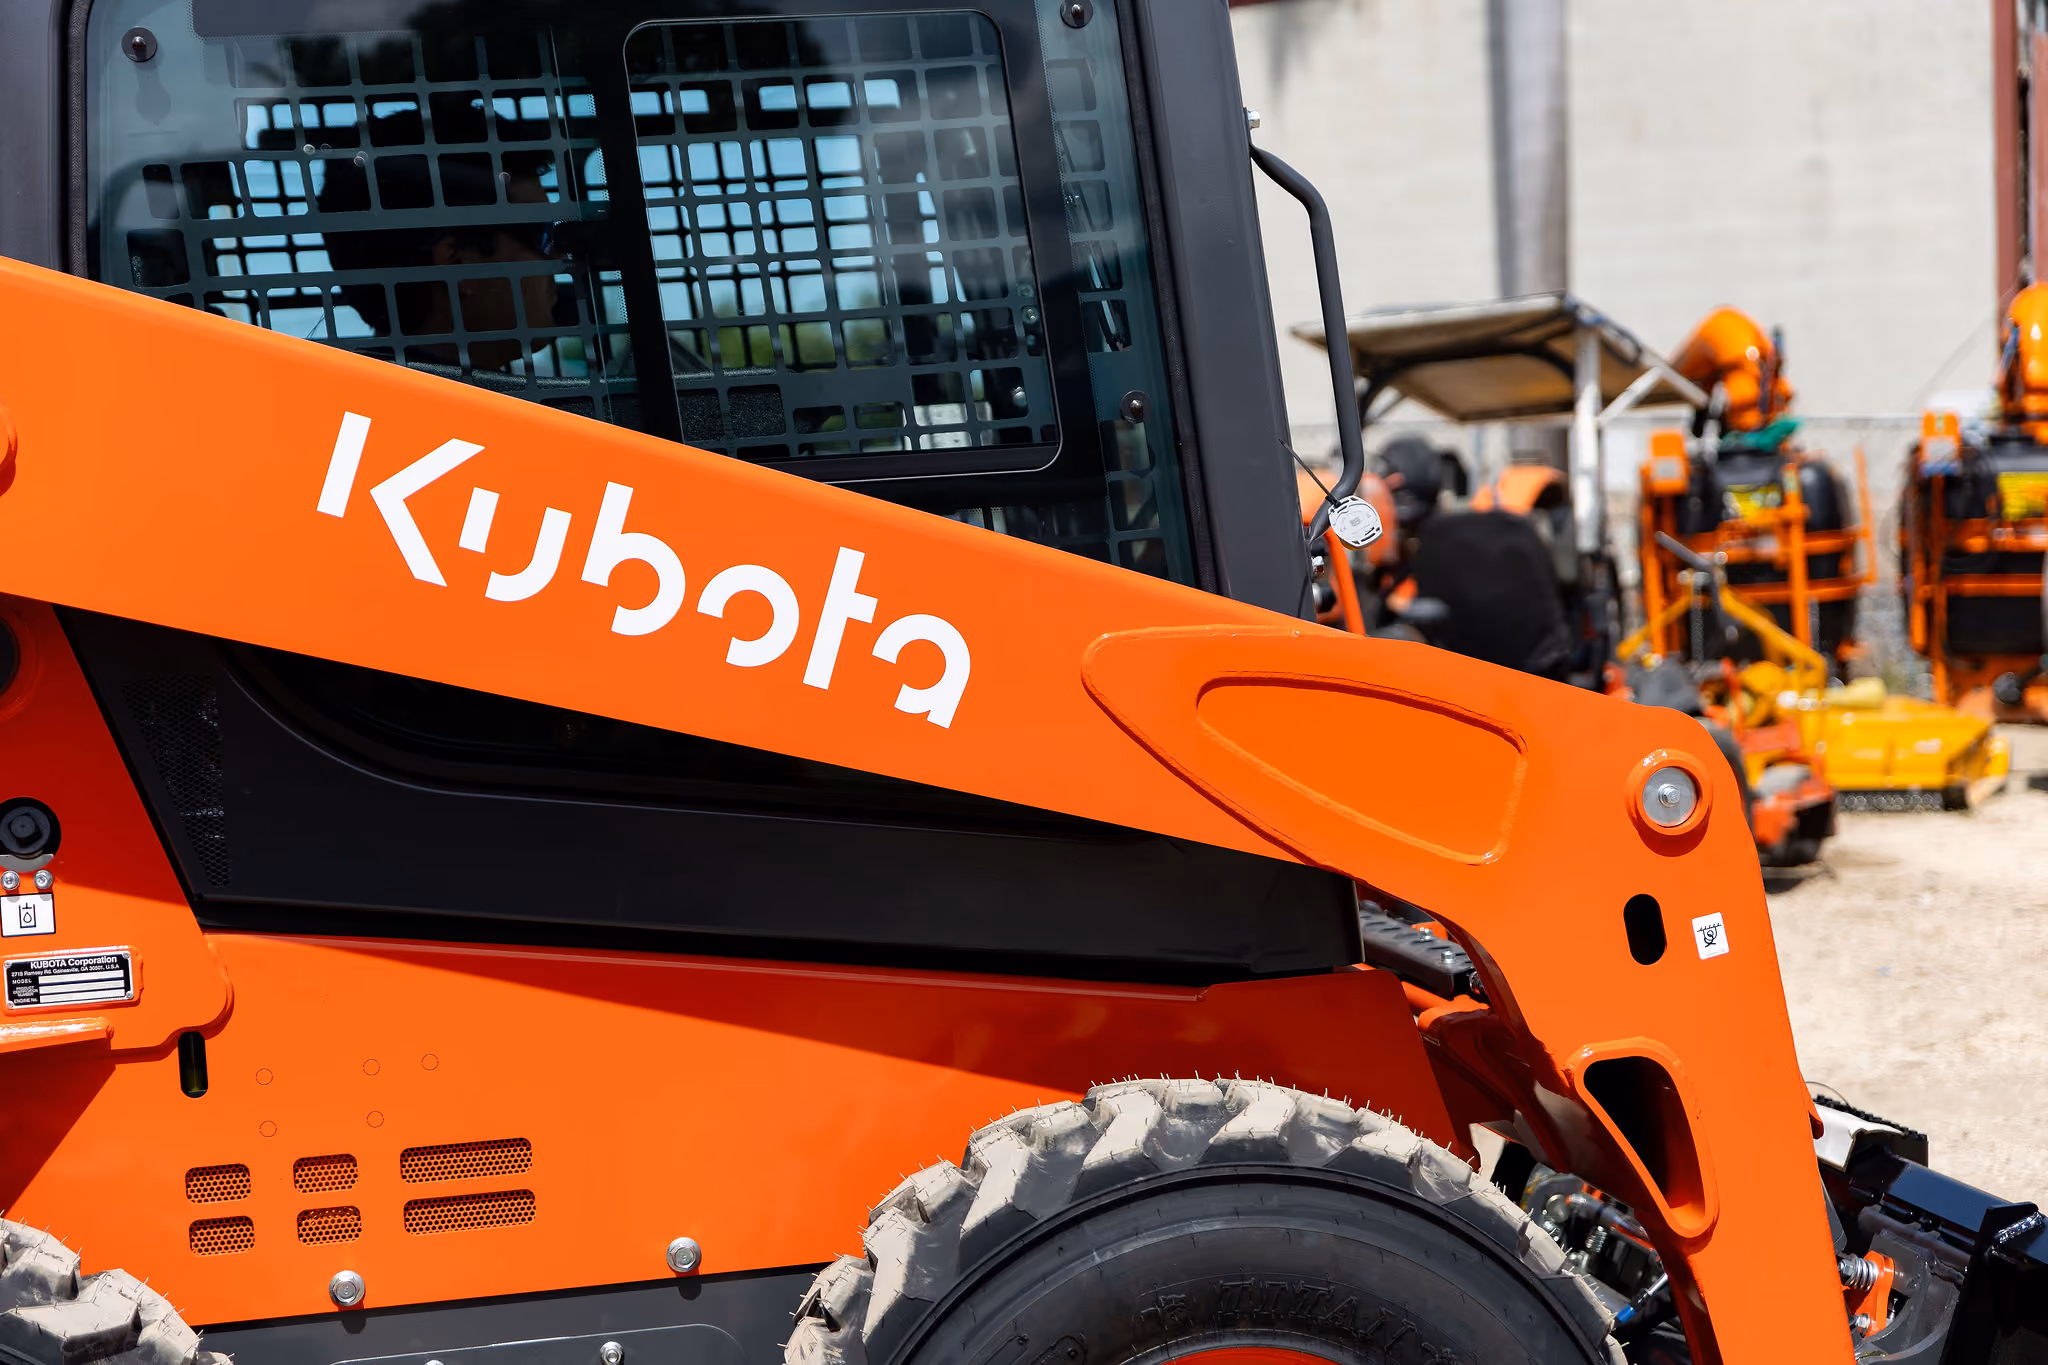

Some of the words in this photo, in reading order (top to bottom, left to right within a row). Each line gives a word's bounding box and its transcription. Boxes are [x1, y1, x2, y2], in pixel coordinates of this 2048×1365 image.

[316, 410, 971, 729] Kubota
[30, 959, 67, 969] KUBOTA
[67, 956, 117, 966] Corporation
[1213, 1278, 1421, 1353] TITAN
